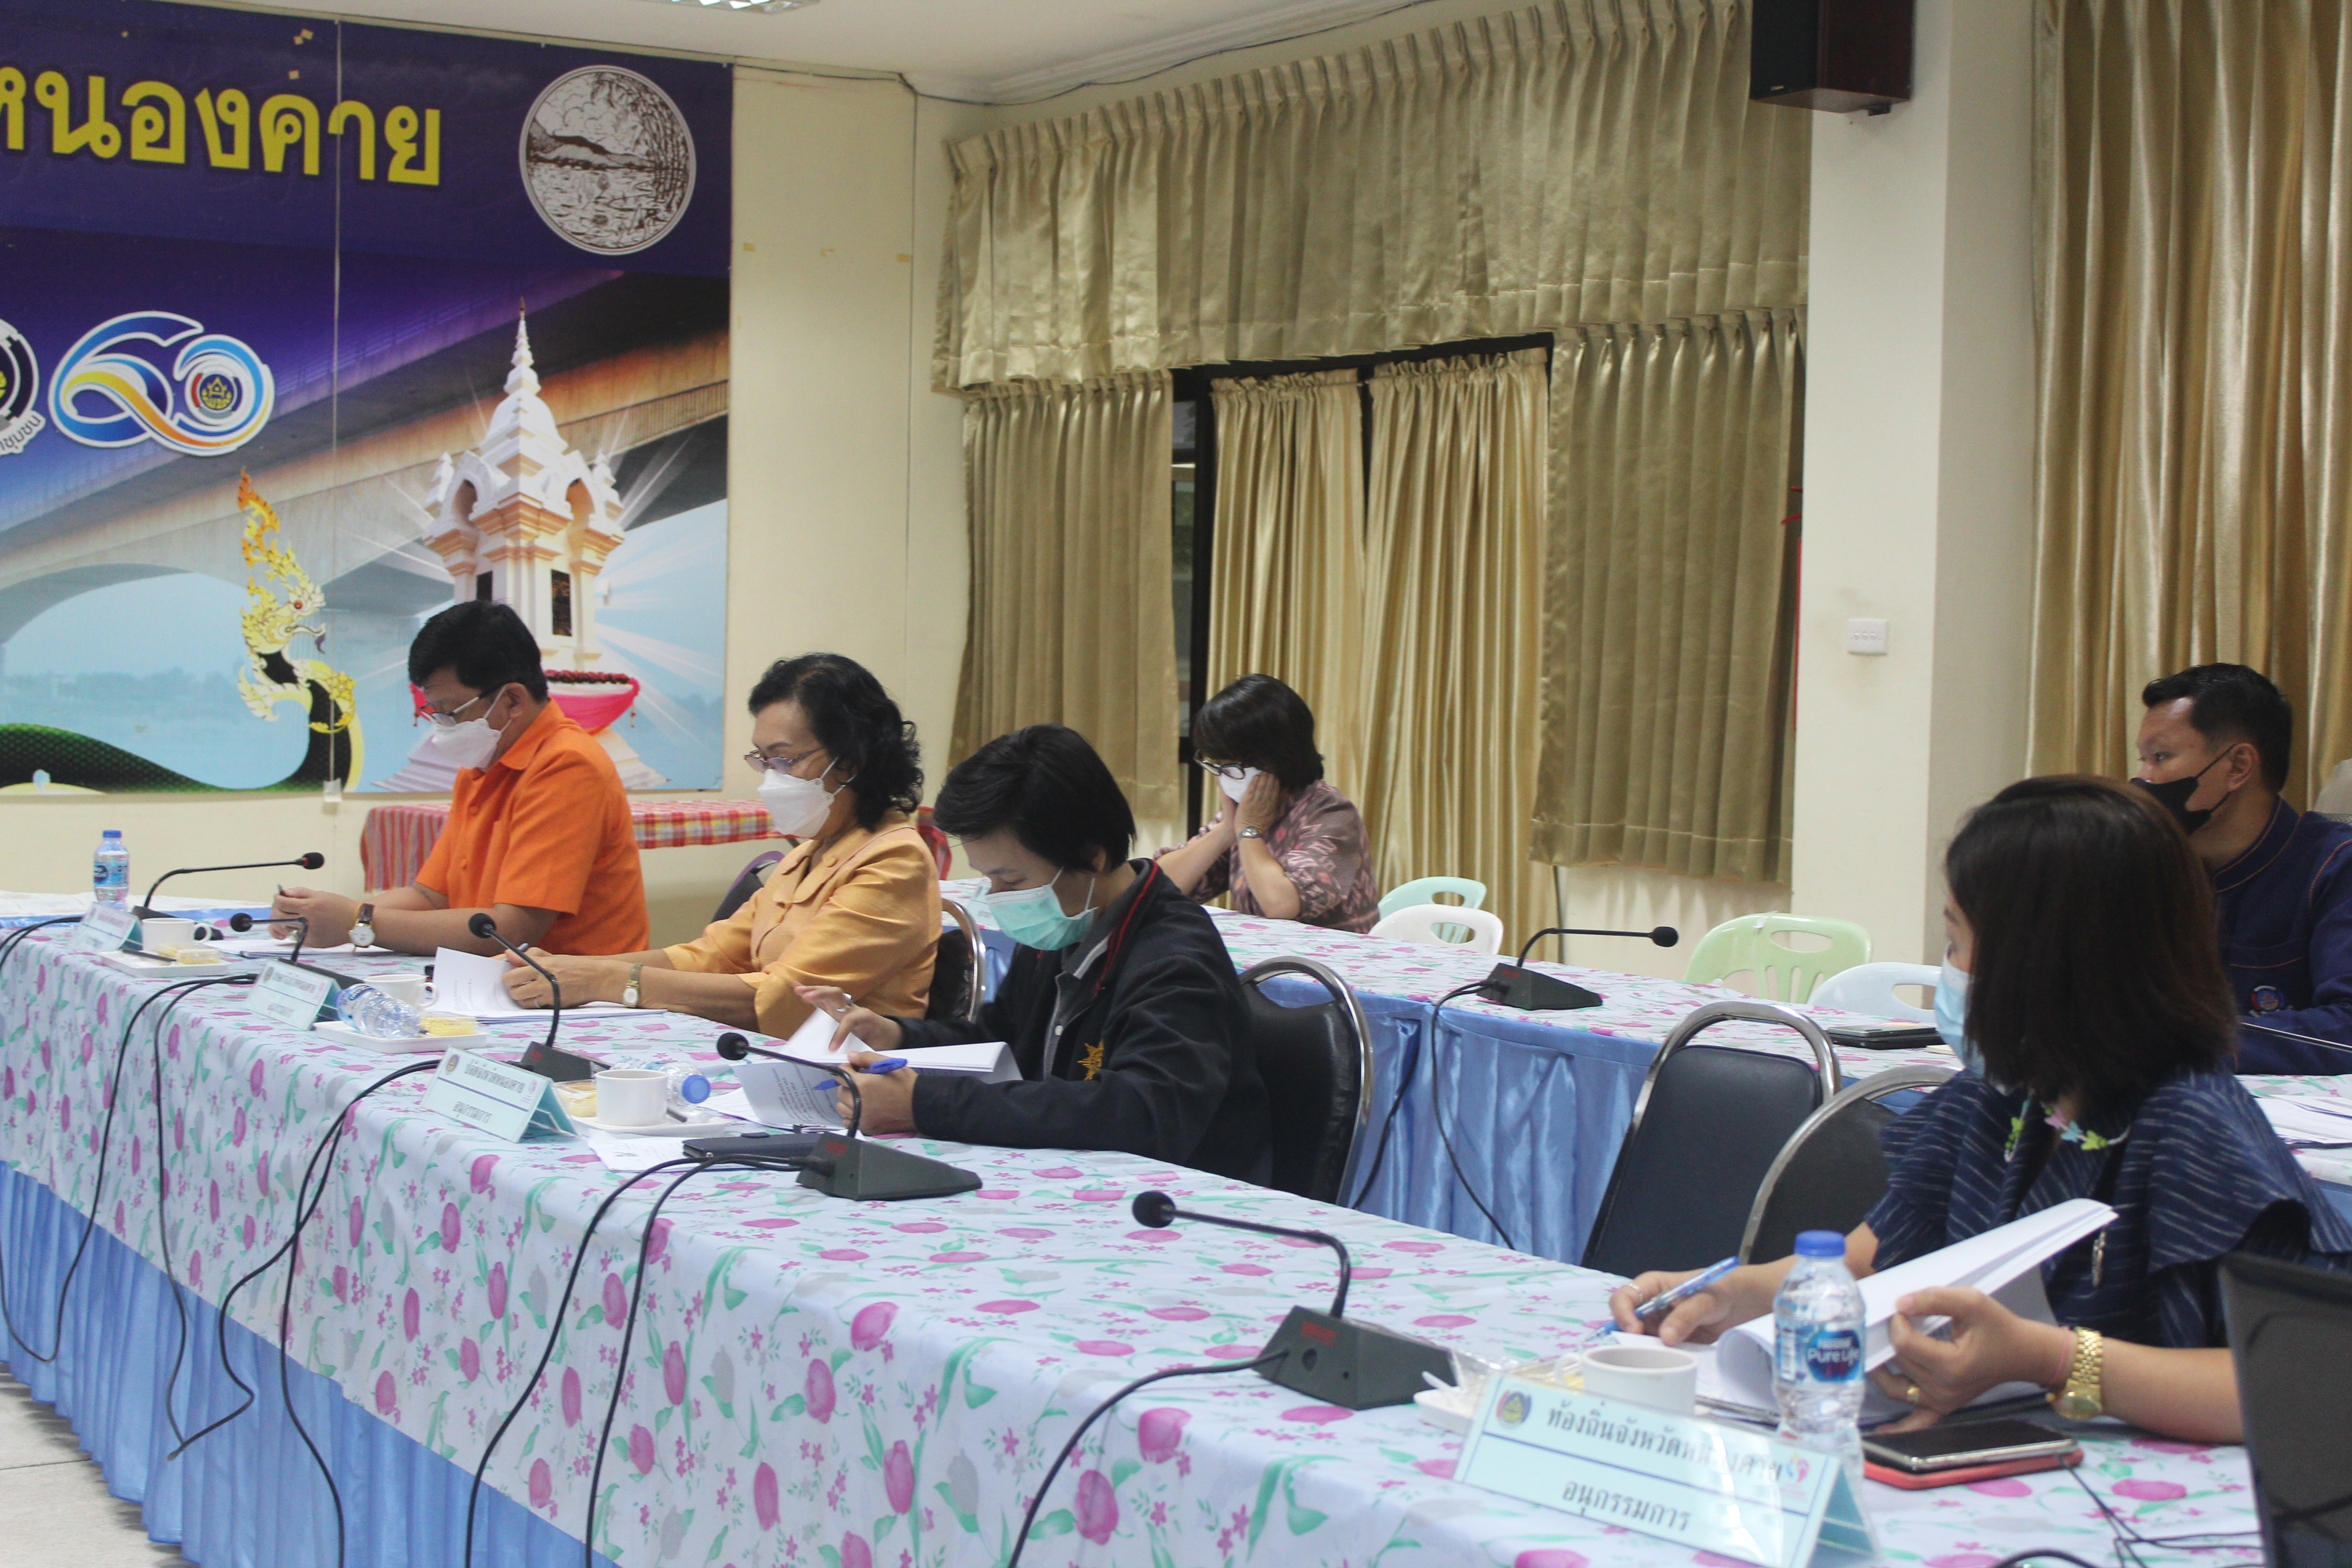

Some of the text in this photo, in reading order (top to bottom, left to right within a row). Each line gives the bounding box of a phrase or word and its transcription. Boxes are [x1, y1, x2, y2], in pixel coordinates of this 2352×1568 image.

[1548, 1399, 1782, 1480] ท้องถิ่นจังหวัดหนงคาย
[1562, 1480, 1692, 1531] อนุกรรมการ
